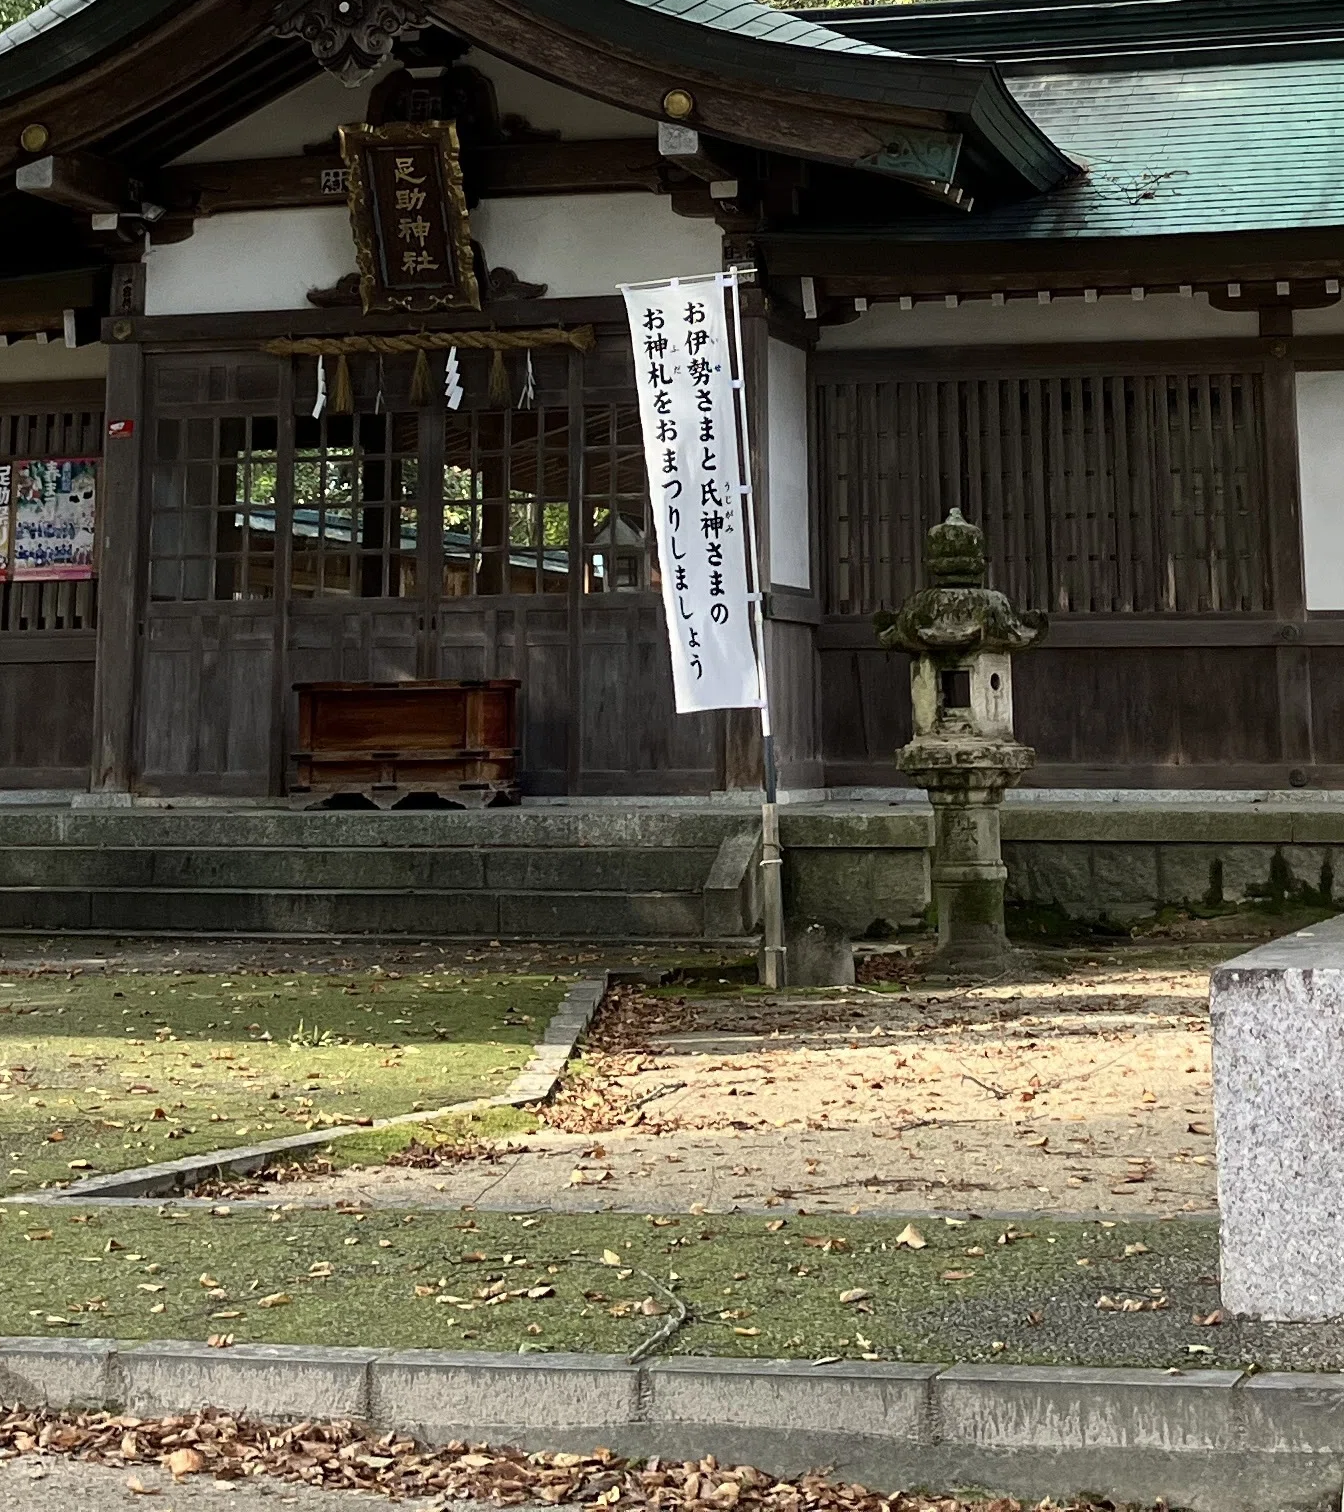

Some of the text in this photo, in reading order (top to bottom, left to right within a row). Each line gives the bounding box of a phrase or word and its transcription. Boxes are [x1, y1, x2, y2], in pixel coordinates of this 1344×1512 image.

[394, 157, 440, 276] 足助神社
[642, 307, 705, 681] お神札をおまつりしましょう
[683, 301, 729, 626] お伊勢さまと氏神さまの
